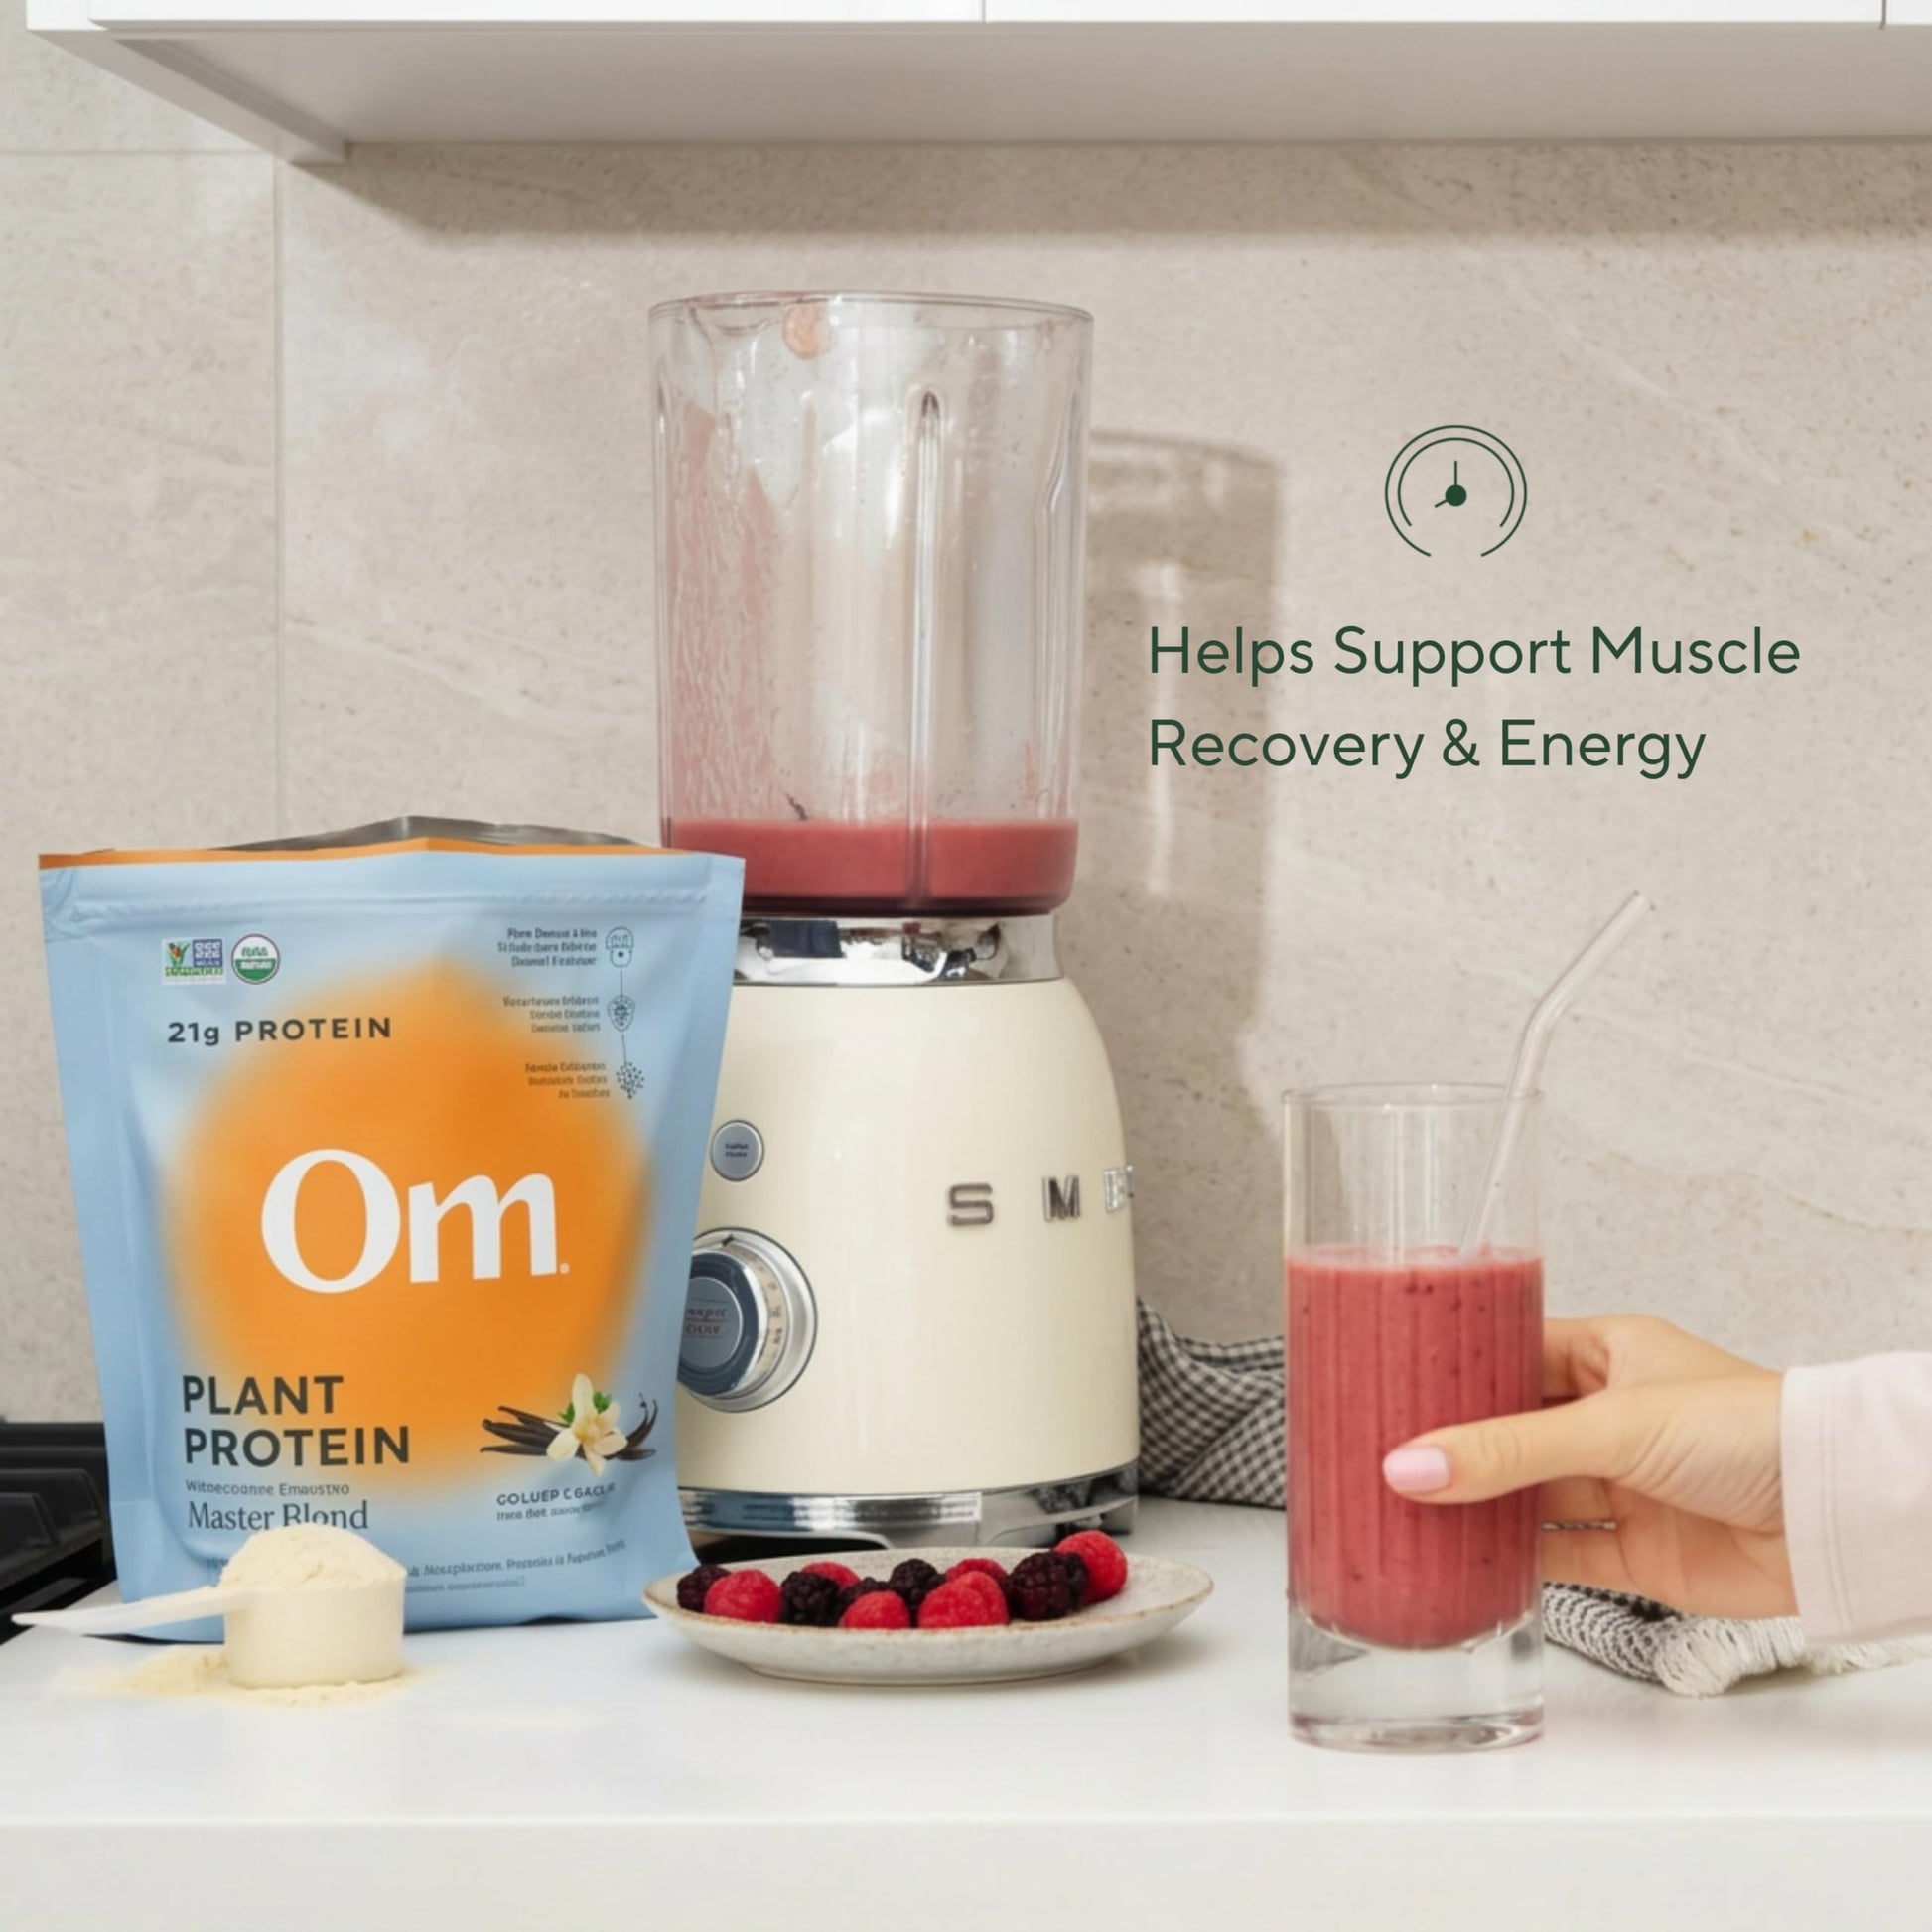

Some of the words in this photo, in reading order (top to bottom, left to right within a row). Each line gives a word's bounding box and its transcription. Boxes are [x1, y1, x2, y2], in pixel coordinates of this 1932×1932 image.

[168, 1022, 220, 1046] 21g
[235, 1017, 392, 1042] PROTEIN
[183, 1375, 344, 1415] PLANT
[185, 1426, 409, 1467] PROTEIN
[189, 1501, 275, 1531] Master
